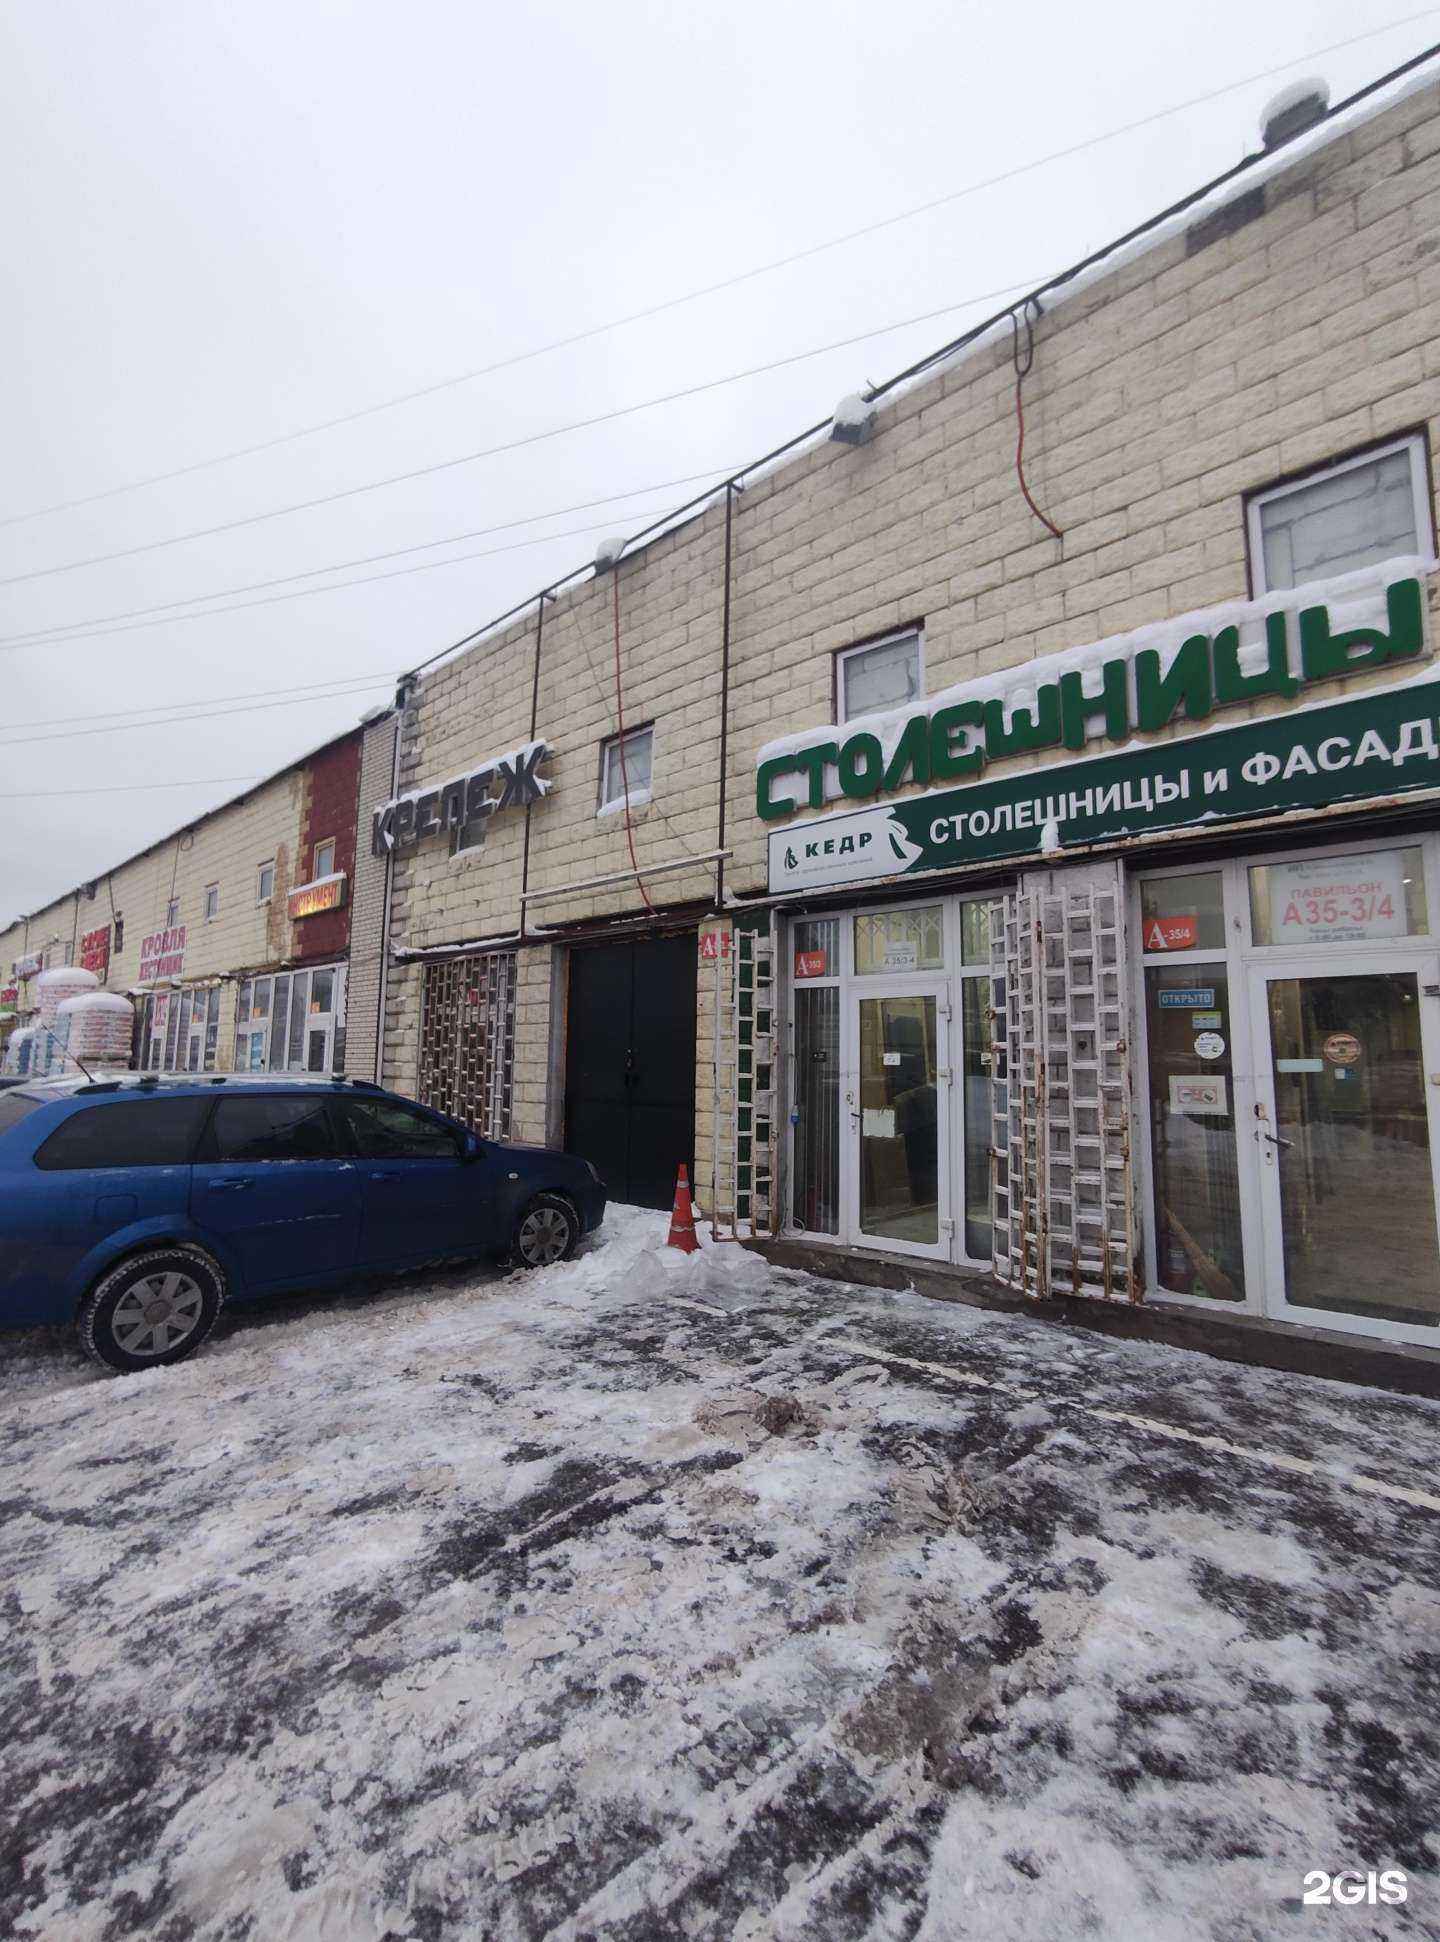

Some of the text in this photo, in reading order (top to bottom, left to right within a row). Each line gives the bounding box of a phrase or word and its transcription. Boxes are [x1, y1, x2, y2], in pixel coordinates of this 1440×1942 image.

[757, 577, 1424, 821] СТОЛЕШНИЦЫ
[929, 718, 1440, 844] СТОЛЕШНИЦЫ и ФАСАД
[371, 743, 552, 856] КРЕПЕЖ
[805, 832, 873, 858] КЕДР
[1290, 880, 1382, 900] ПАВИЛЬОН
[141, 925, 186, 959] КРОВЛЯ
[1161, 991, 1211, 1005] ОТКРЫТО
